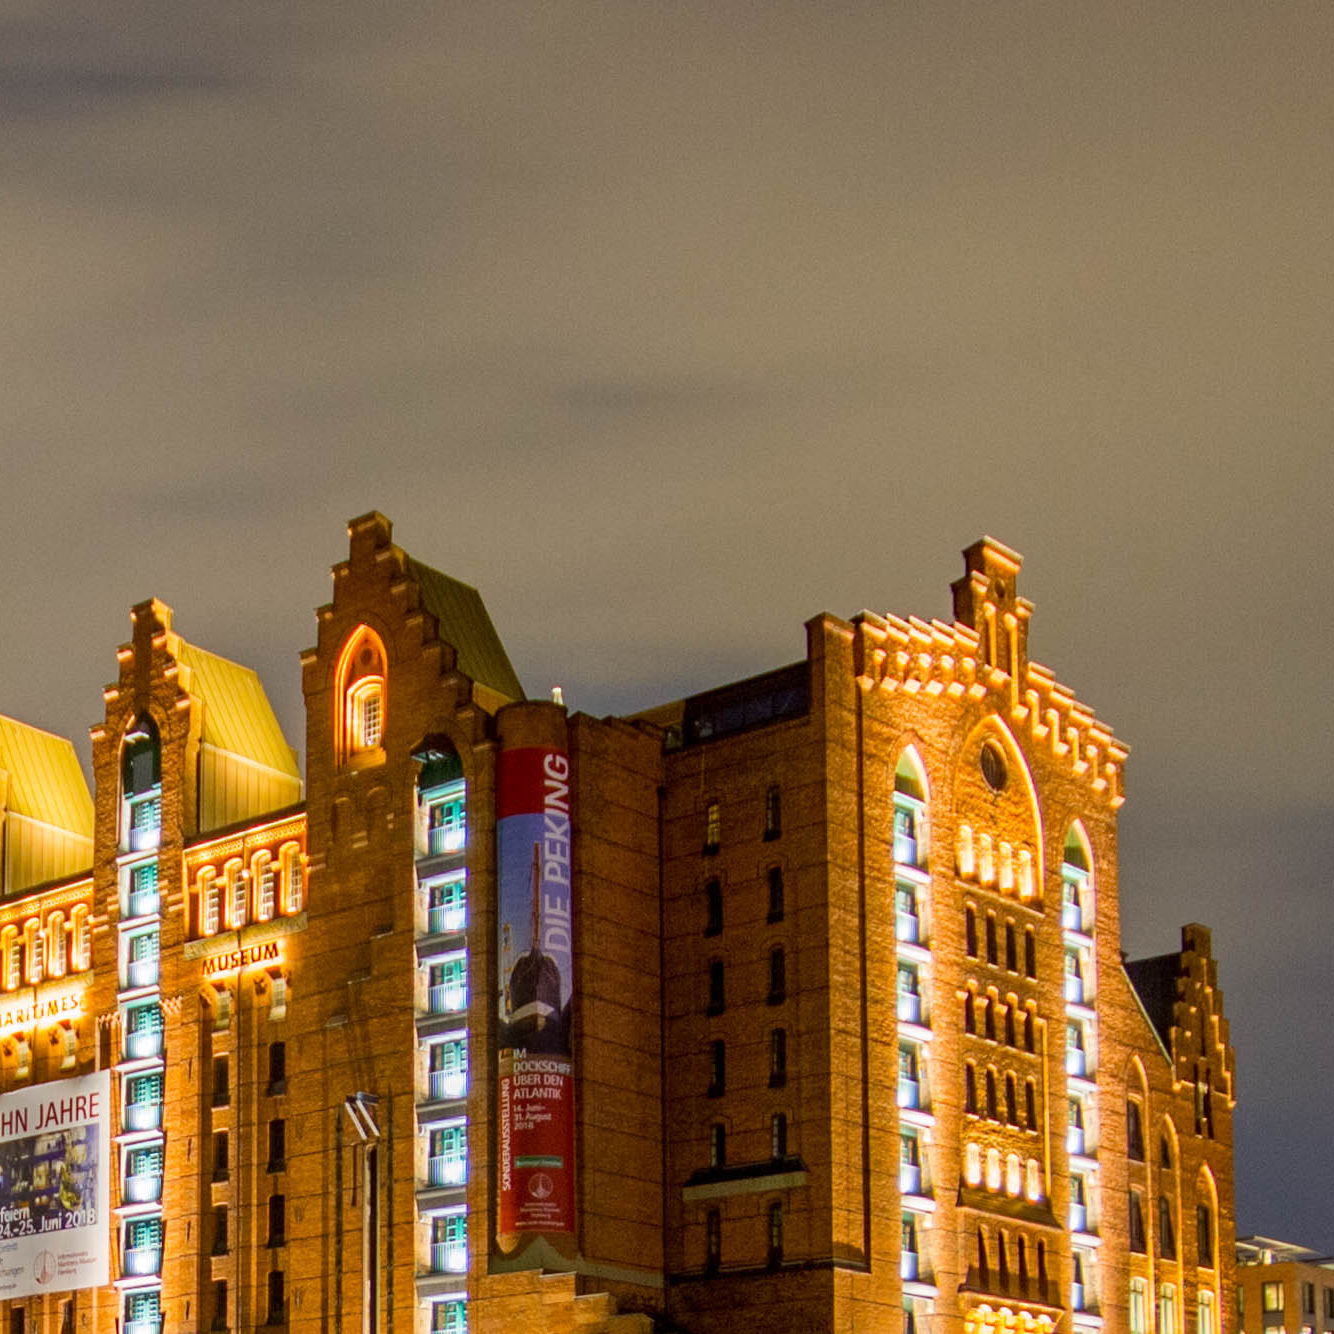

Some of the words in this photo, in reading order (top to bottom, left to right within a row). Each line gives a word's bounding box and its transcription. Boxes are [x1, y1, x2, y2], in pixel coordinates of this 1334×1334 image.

[544, 754, 570, 885] PEKING
[544, 893, 571, 952] DIE
[202, 942, 279, 976] MUSEUM
[513, 1048, 526, 1059] IM
[513, 1072, 541, 1086] ÜBER
[544, 1074, 564, 1087] DEN
[513, 1087, 561, 1100] ATLANTIK
[35, 1092, 99, 1130] JAHRE
[525, 1112, 552, 1123] August
[501, 1078, 512, 1191] SONDERAUSSTELLUNG
[0, 1205, 30, 1223] feiern
[38, 1211, 62, 1233] Juni
[65, 1207, 96, 1229] 2018
